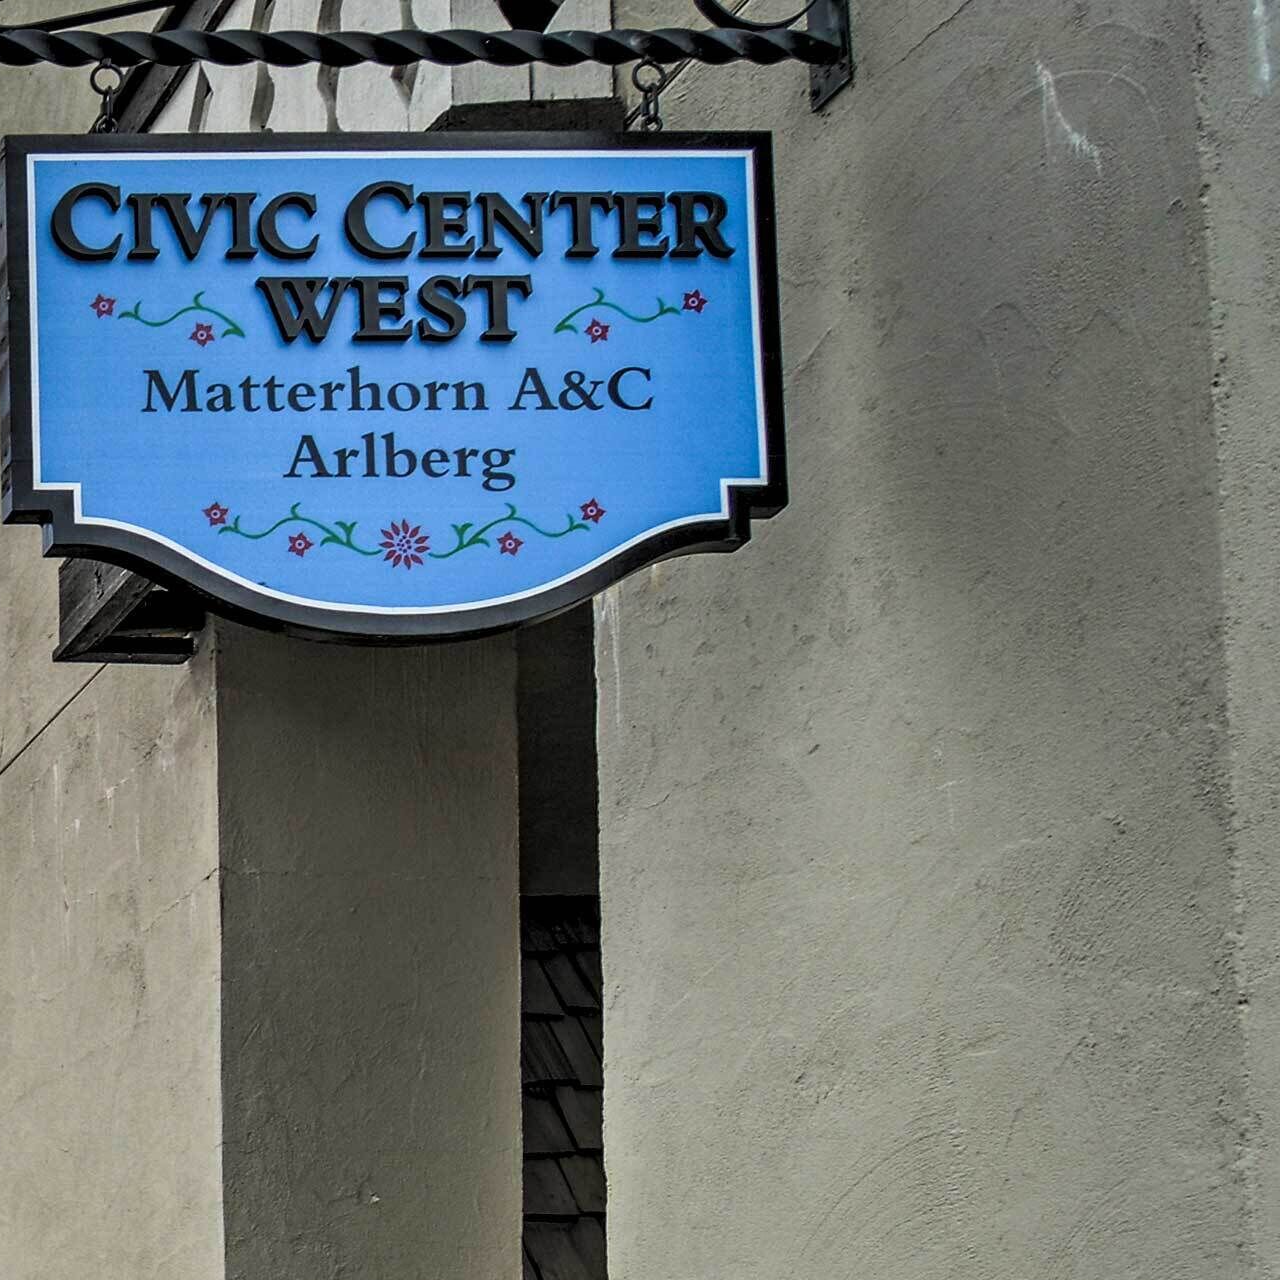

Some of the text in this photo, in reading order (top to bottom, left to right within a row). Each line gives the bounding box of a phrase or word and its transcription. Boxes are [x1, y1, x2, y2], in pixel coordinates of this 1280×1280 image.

[50, 181, 735, 260] CIVIC CENTER
[255, 274, 533, 344] WEST
[142, 365, 654, 412] Matterhorn A&C
[282, 431, 517, 492] Arlberg
